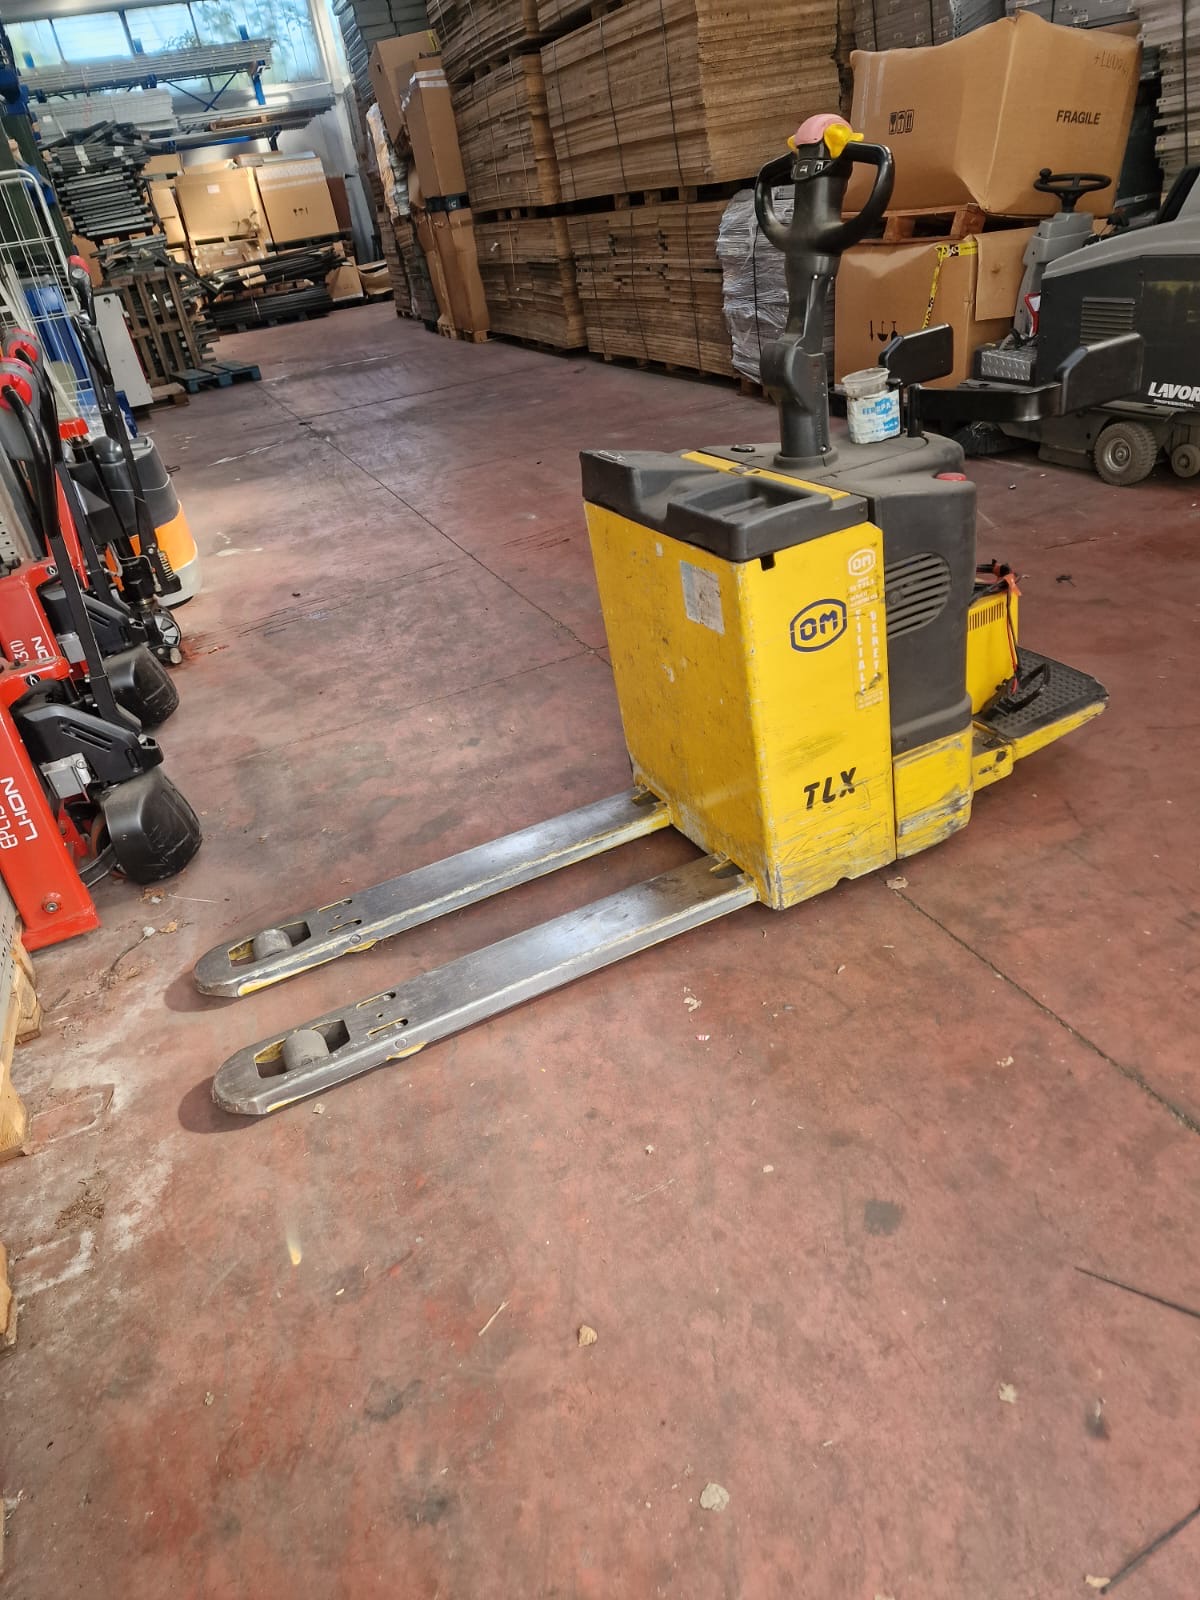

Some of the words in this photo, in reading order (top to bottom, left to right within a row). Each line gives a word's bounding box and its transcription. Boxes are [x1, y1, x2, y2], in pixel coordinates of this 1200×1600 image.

[1056, 110, 1101, 125] FRAGILE
[1148, 381, 1200, 402] LAVOR
[803, 767, 856, 811] TLX
